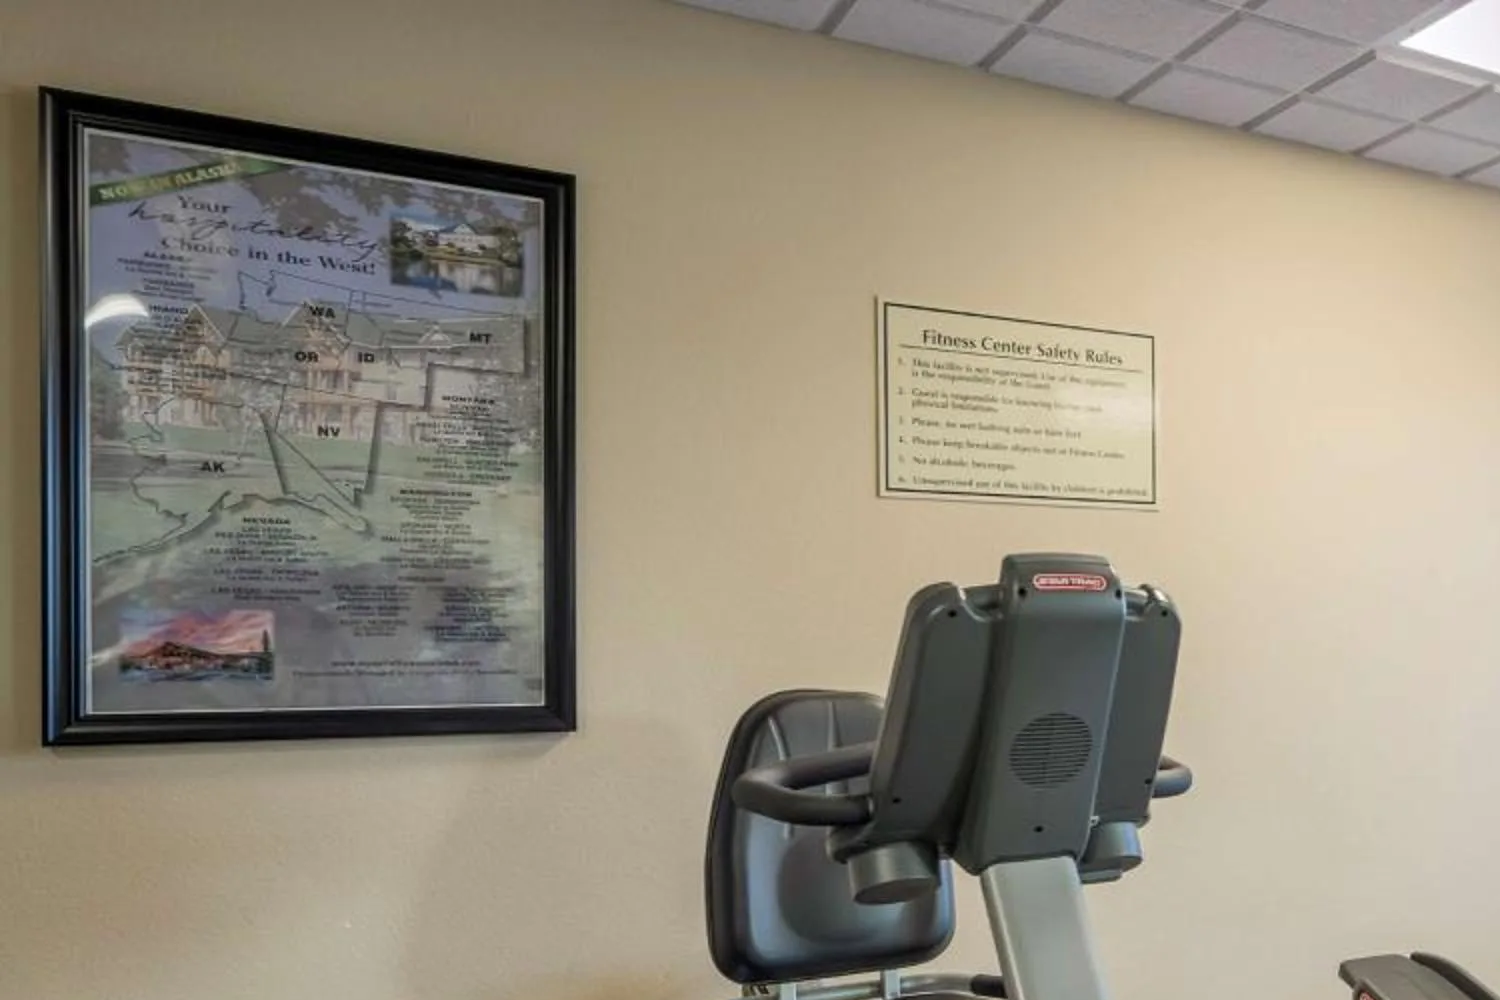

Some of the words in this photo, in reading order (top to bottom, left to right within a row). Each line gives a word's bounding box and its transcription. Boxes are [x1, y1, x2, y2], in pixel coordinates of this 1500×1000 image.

[177, 195, 232, 214] Your
[161, 237, 240, 257] Choice
[247, 246, 269, 260] in
[277, 251, 312, 266] the
[317, 255, 376, 275] West!
[308, 306, 336, 319] WA
[469, 333, 492, 344] MT
[922, 328, 978, 349] Fitness
[980, 335, 1032, 355] Center
[1036, 343, 1080, 361] Safety
[1085, 347, 1124, 365] Rules
[294, 352, 319, 362] OR
[357, 352, 375, 362] ID
[317, 425, 341, 437] NV
[200, 461, 226, 473] AK
